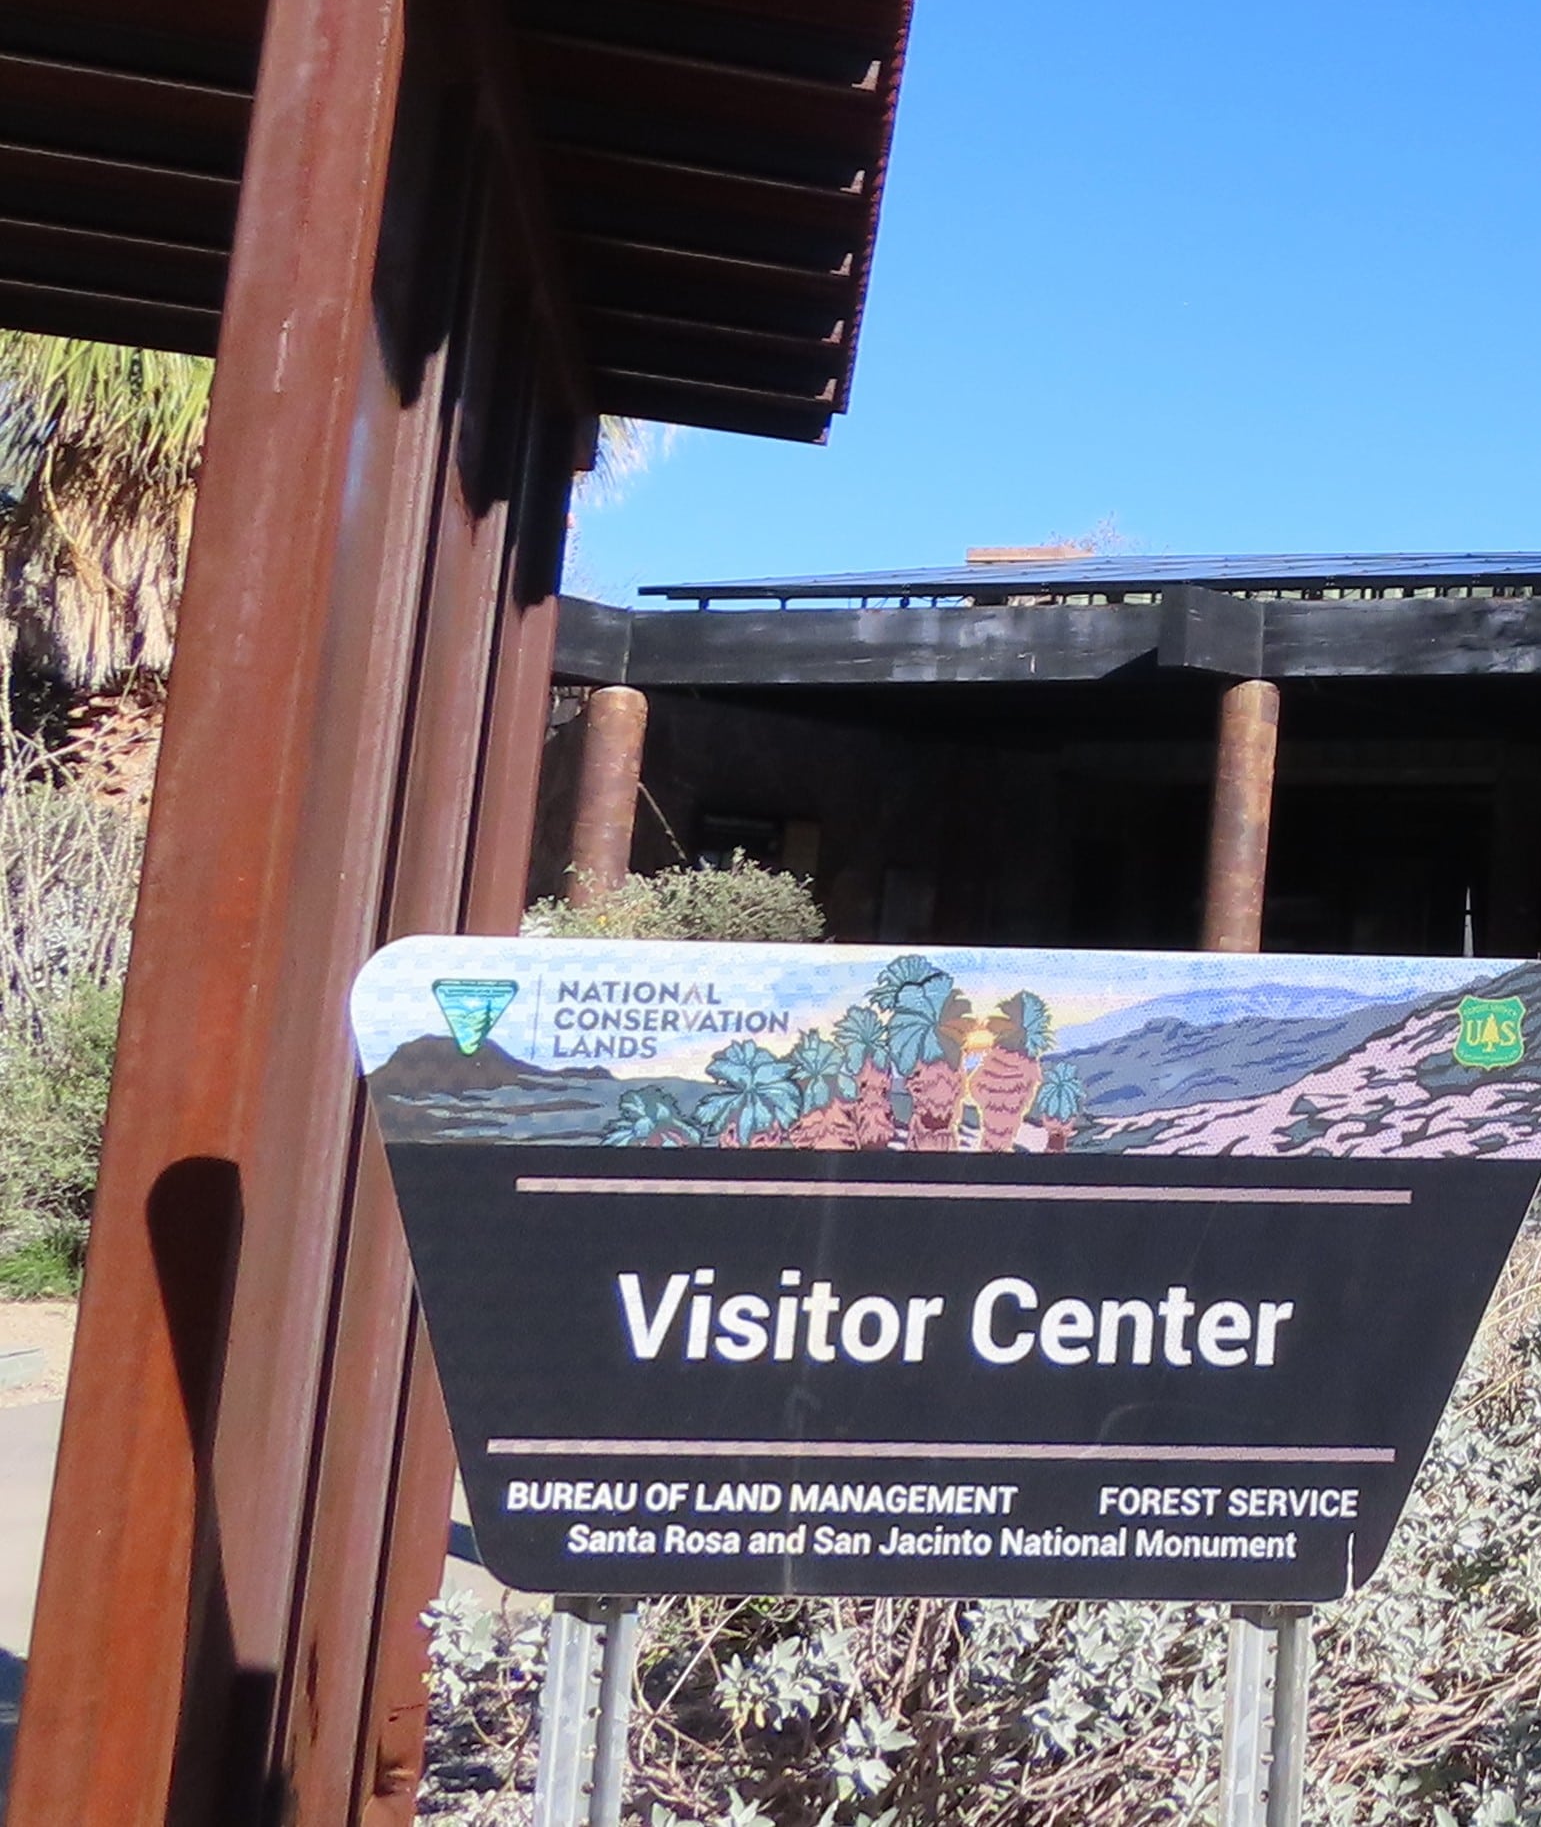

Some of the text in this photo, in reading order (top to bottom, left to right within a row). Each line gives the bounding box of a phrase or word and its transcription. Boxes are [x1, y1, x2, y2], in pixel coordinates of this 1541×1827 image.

[557, 980, 721, 1006] NATIONAL
[554, 1009, 789, 1034] CONSERVATION
[552, 1035, 657, 1059] LANDS
[618, 1269, 1294, 1367] Visitor Center
[506, 1481, 1019, 1515] BUREAU OF LAND MANAGEMENT
[1099, 1486, 1359, 1518] FOREST SERVICE
[567, 1523, 1298, 1559] Santa Rosa and San Jacinto National Monument
